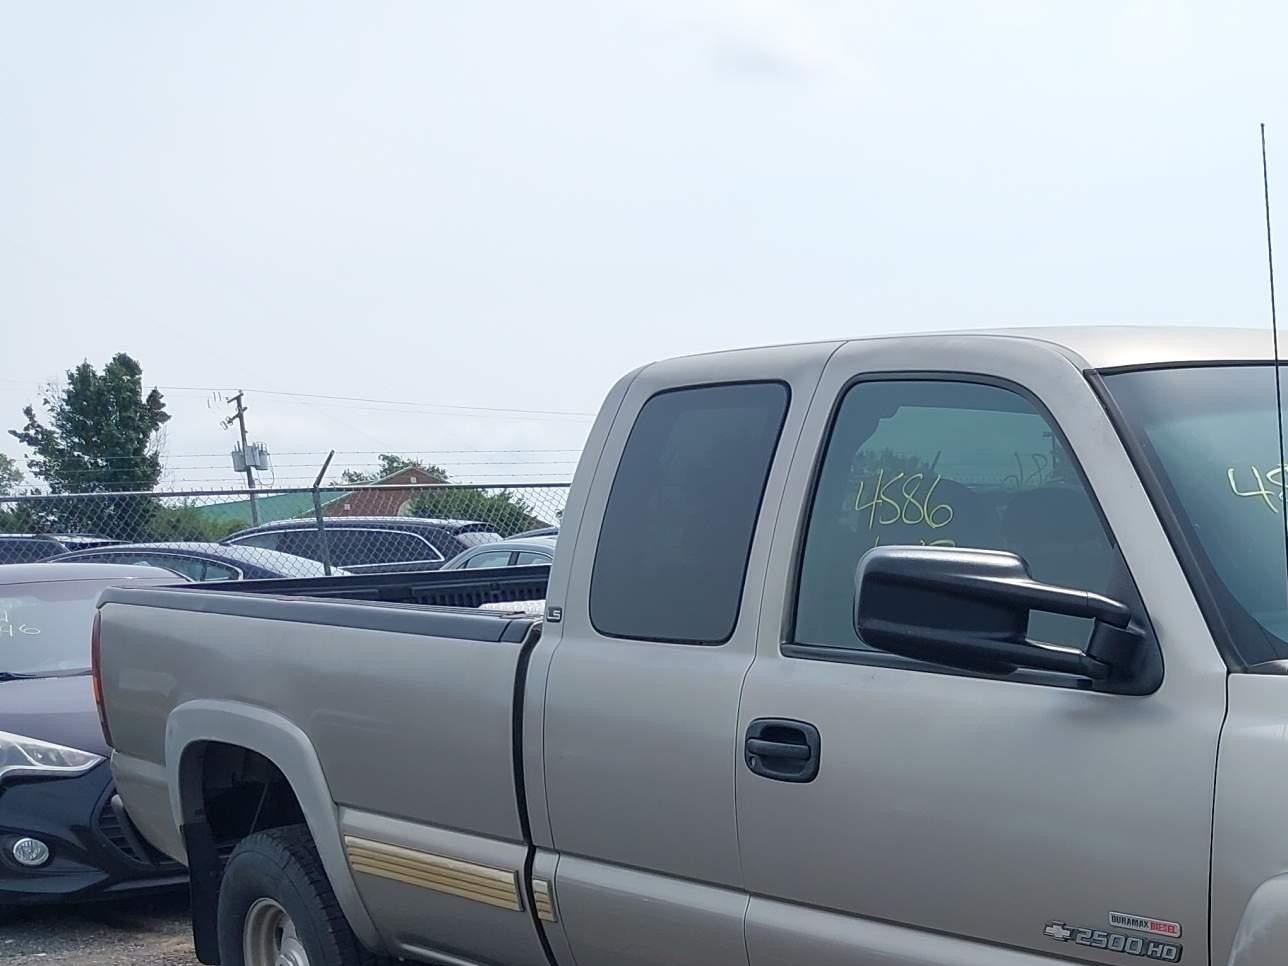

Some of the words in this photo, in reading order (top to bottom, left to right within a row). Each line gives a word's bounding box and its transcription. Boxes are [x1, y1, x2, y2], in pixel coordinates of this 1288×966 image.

[855, 467, 953, 529] 4586
[547, 609, 561, 620] LS
[1111, 914, 1149, 929] DURAMAX
[1150, 920, 1177, 934] DIESEL
[1075, 928, 1143, 955] 2500
[1147, 942, 1177, 960] HD
